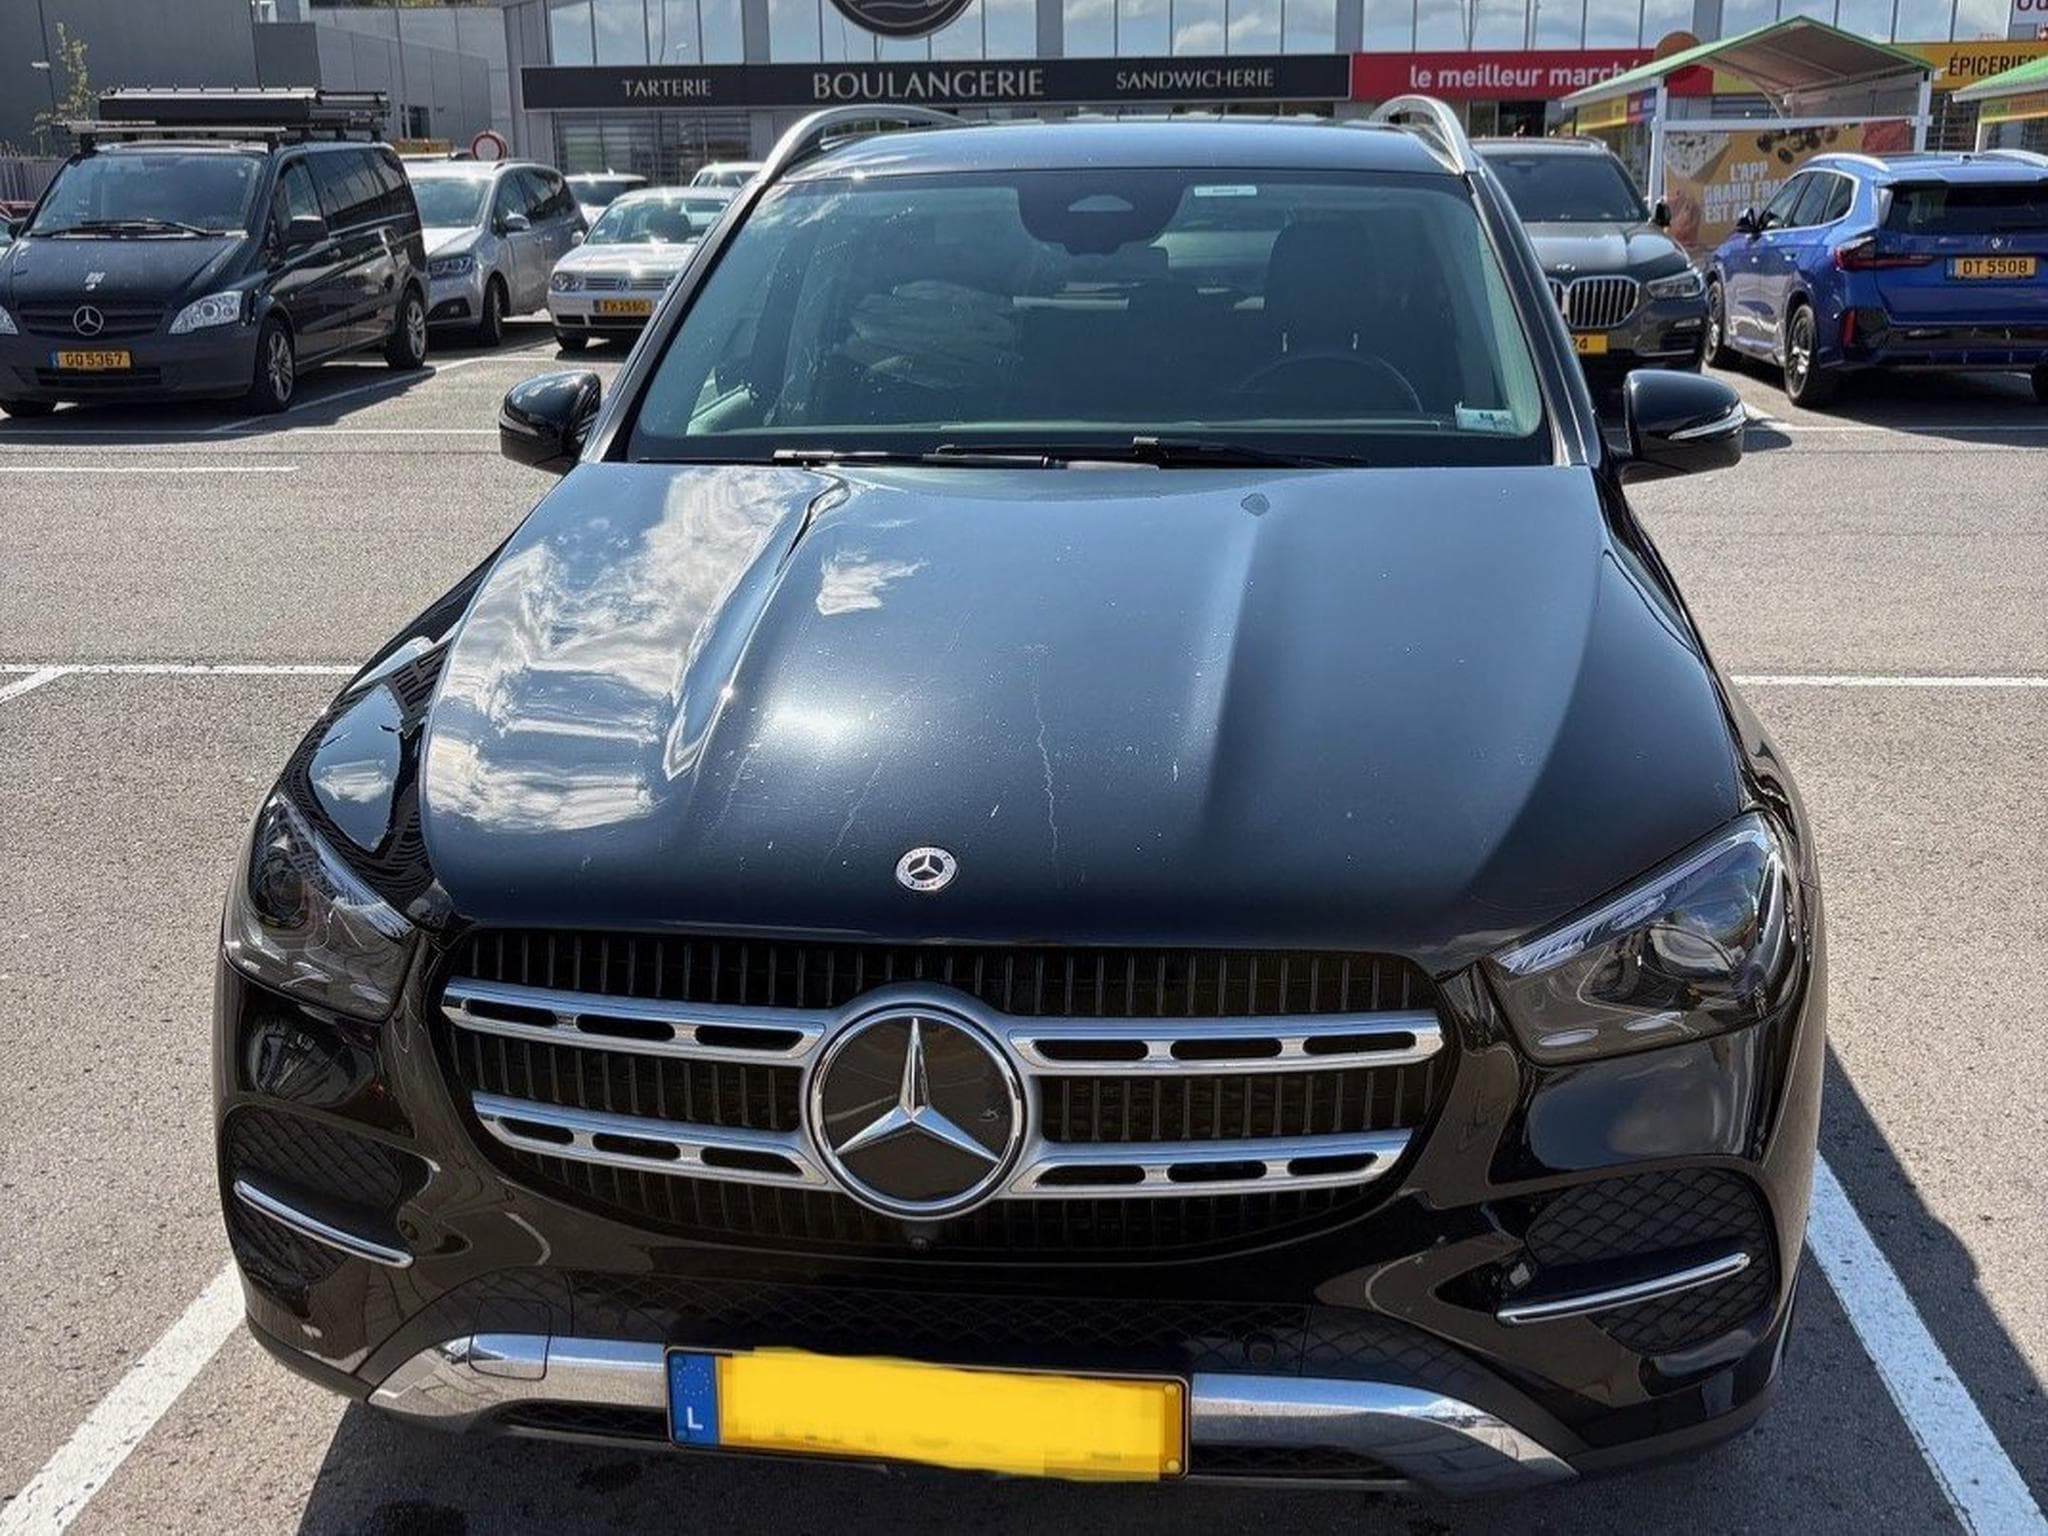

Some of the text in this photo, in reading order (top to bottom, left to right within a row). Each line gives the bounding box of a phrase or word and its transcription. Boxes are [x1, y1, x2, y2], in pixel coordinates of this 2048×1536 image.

[813, 69, 1044, 100] BOULANGERIE
[1115, 67, 1274, 91] SANDWICHERIE
[1410, 60, 1641, 89] le meilleur march
[621, 79, 711, 97] TARTERIE
[1962, 260, 2028, 275] DT 5508
[687, 1405, 704, 1430] L
